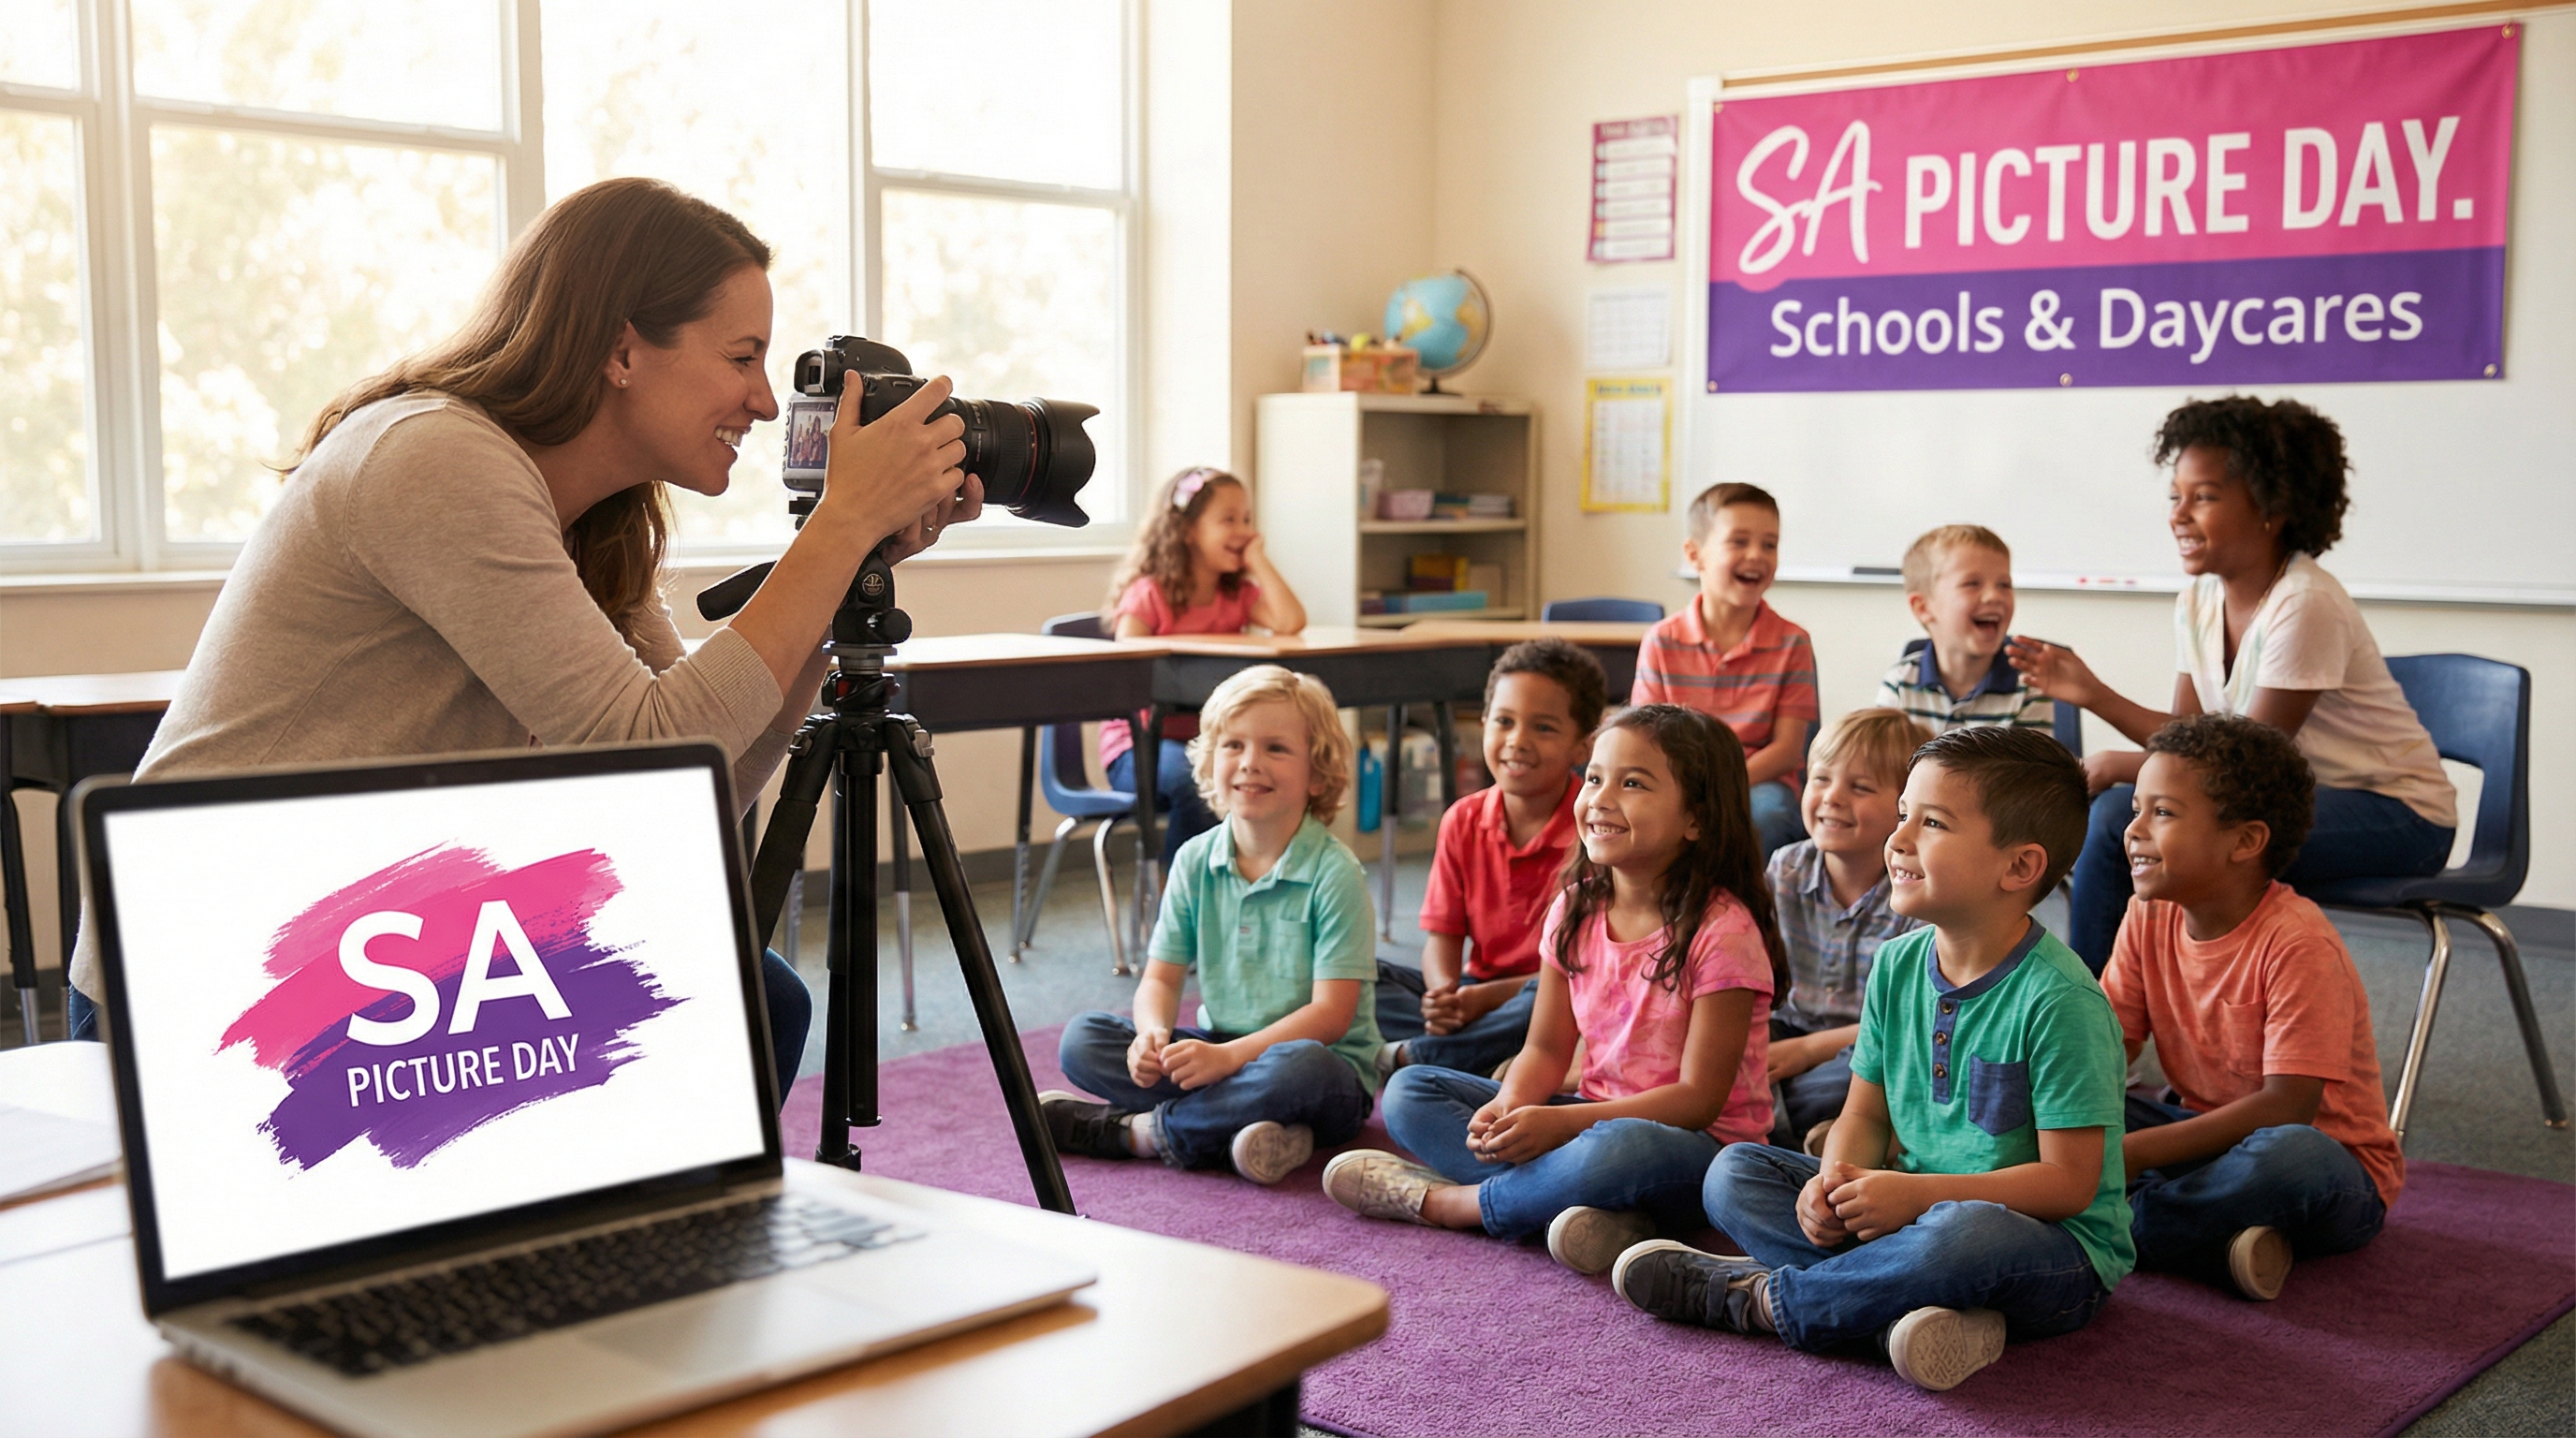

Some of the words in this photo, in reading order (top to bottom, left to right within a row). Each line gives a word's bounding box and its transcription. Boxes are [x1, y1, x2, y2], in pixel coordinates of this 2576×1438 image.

[1736, 120, 1883, 275] SA
[1904, 132, 2250, 250] PICTURE
[2282, 116, 2474, 230] DAY.
[1770, 290, 2005, 358] Schools
[2024, 289, 2075, 352] &
[2100, 287, 2423, 365] Daycares
[338, 899, 574, 1047] SA
[346, 1046, 505, 1108] PICTURE
[511, 1033, 580, 1080] DAY
